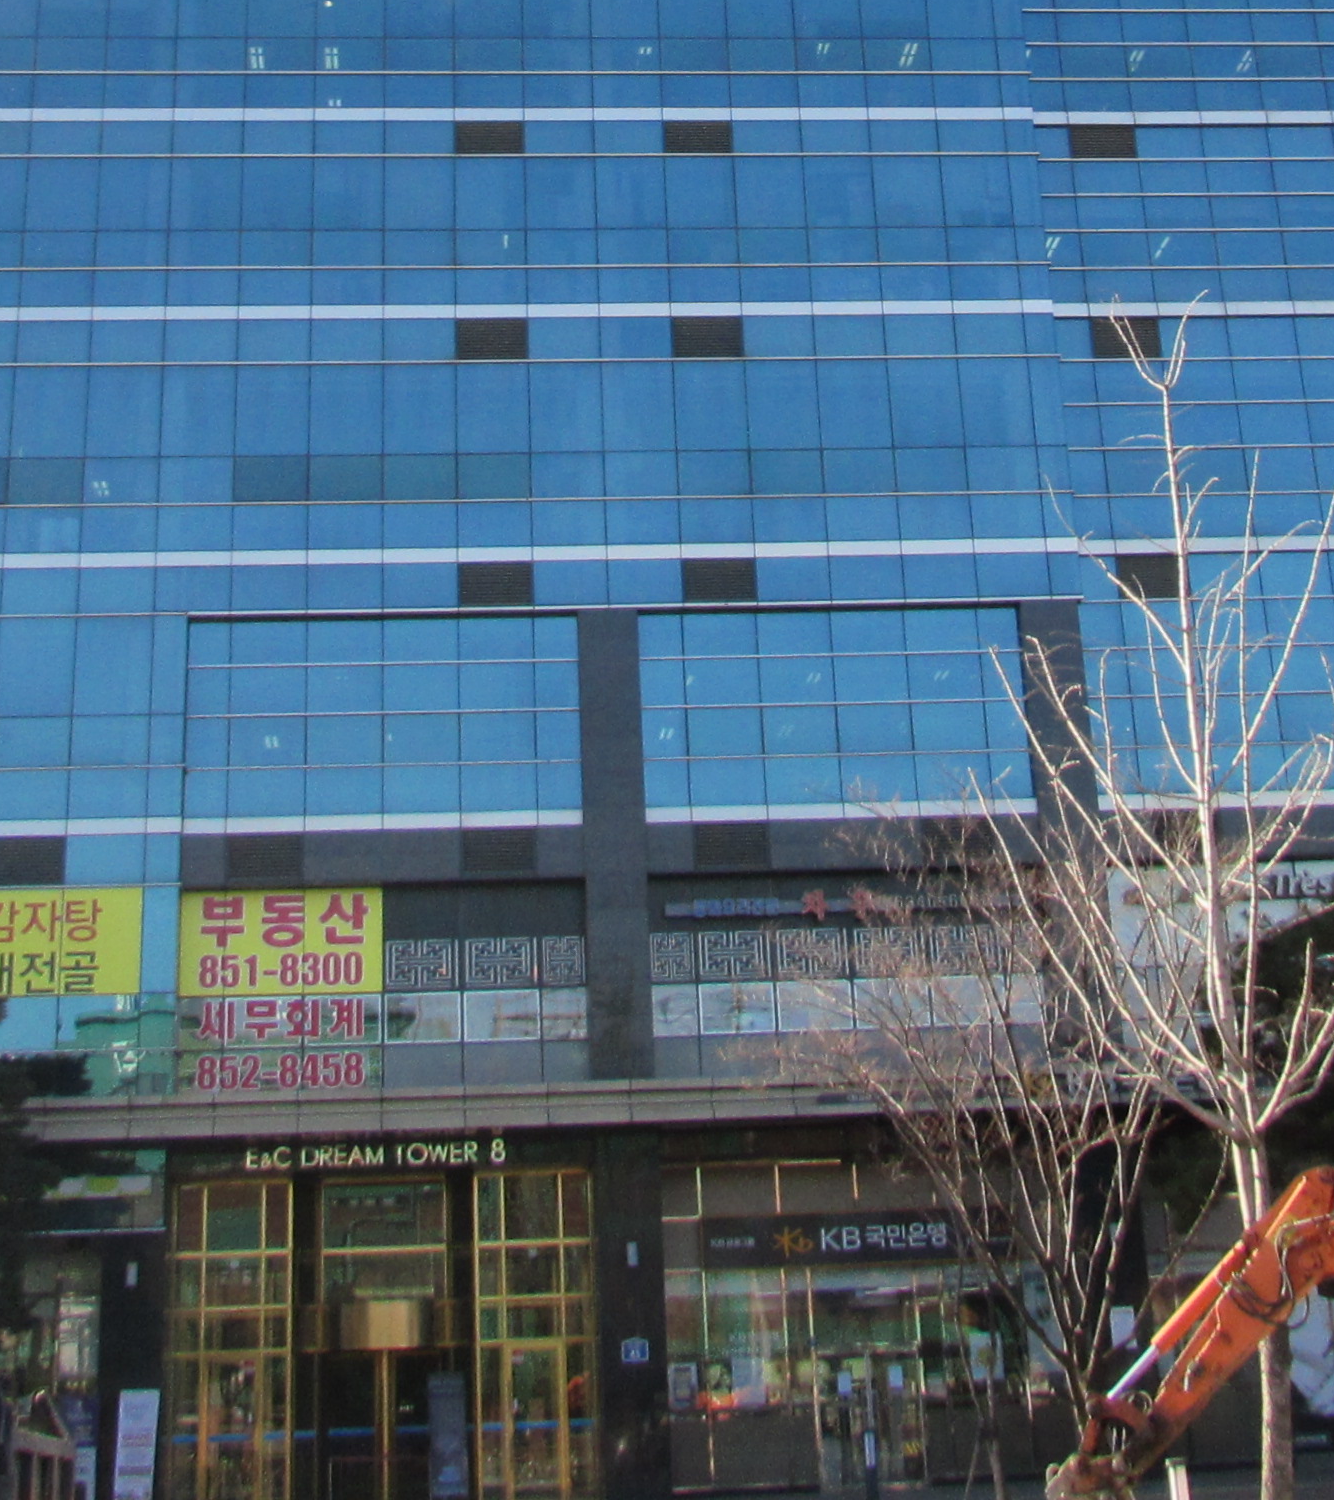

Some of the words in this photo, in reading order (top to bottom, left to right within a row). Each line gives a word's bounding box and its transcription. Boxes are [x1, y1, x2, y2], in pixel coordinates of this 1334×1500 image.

[200, 893, 369, 948] 부동산
[198, 951, 364, 989] 851-8300
[198, 999, 366, 1040] 세무회계
[196, 1052, 365, 1090] 852-8458
[246, 1146, 292, 1169] E&C
[300, 1144, 384, 1169] DREAM
[396, 1140, 478, 1166] TOWER
[490, 1137, 506, 1163] 8
